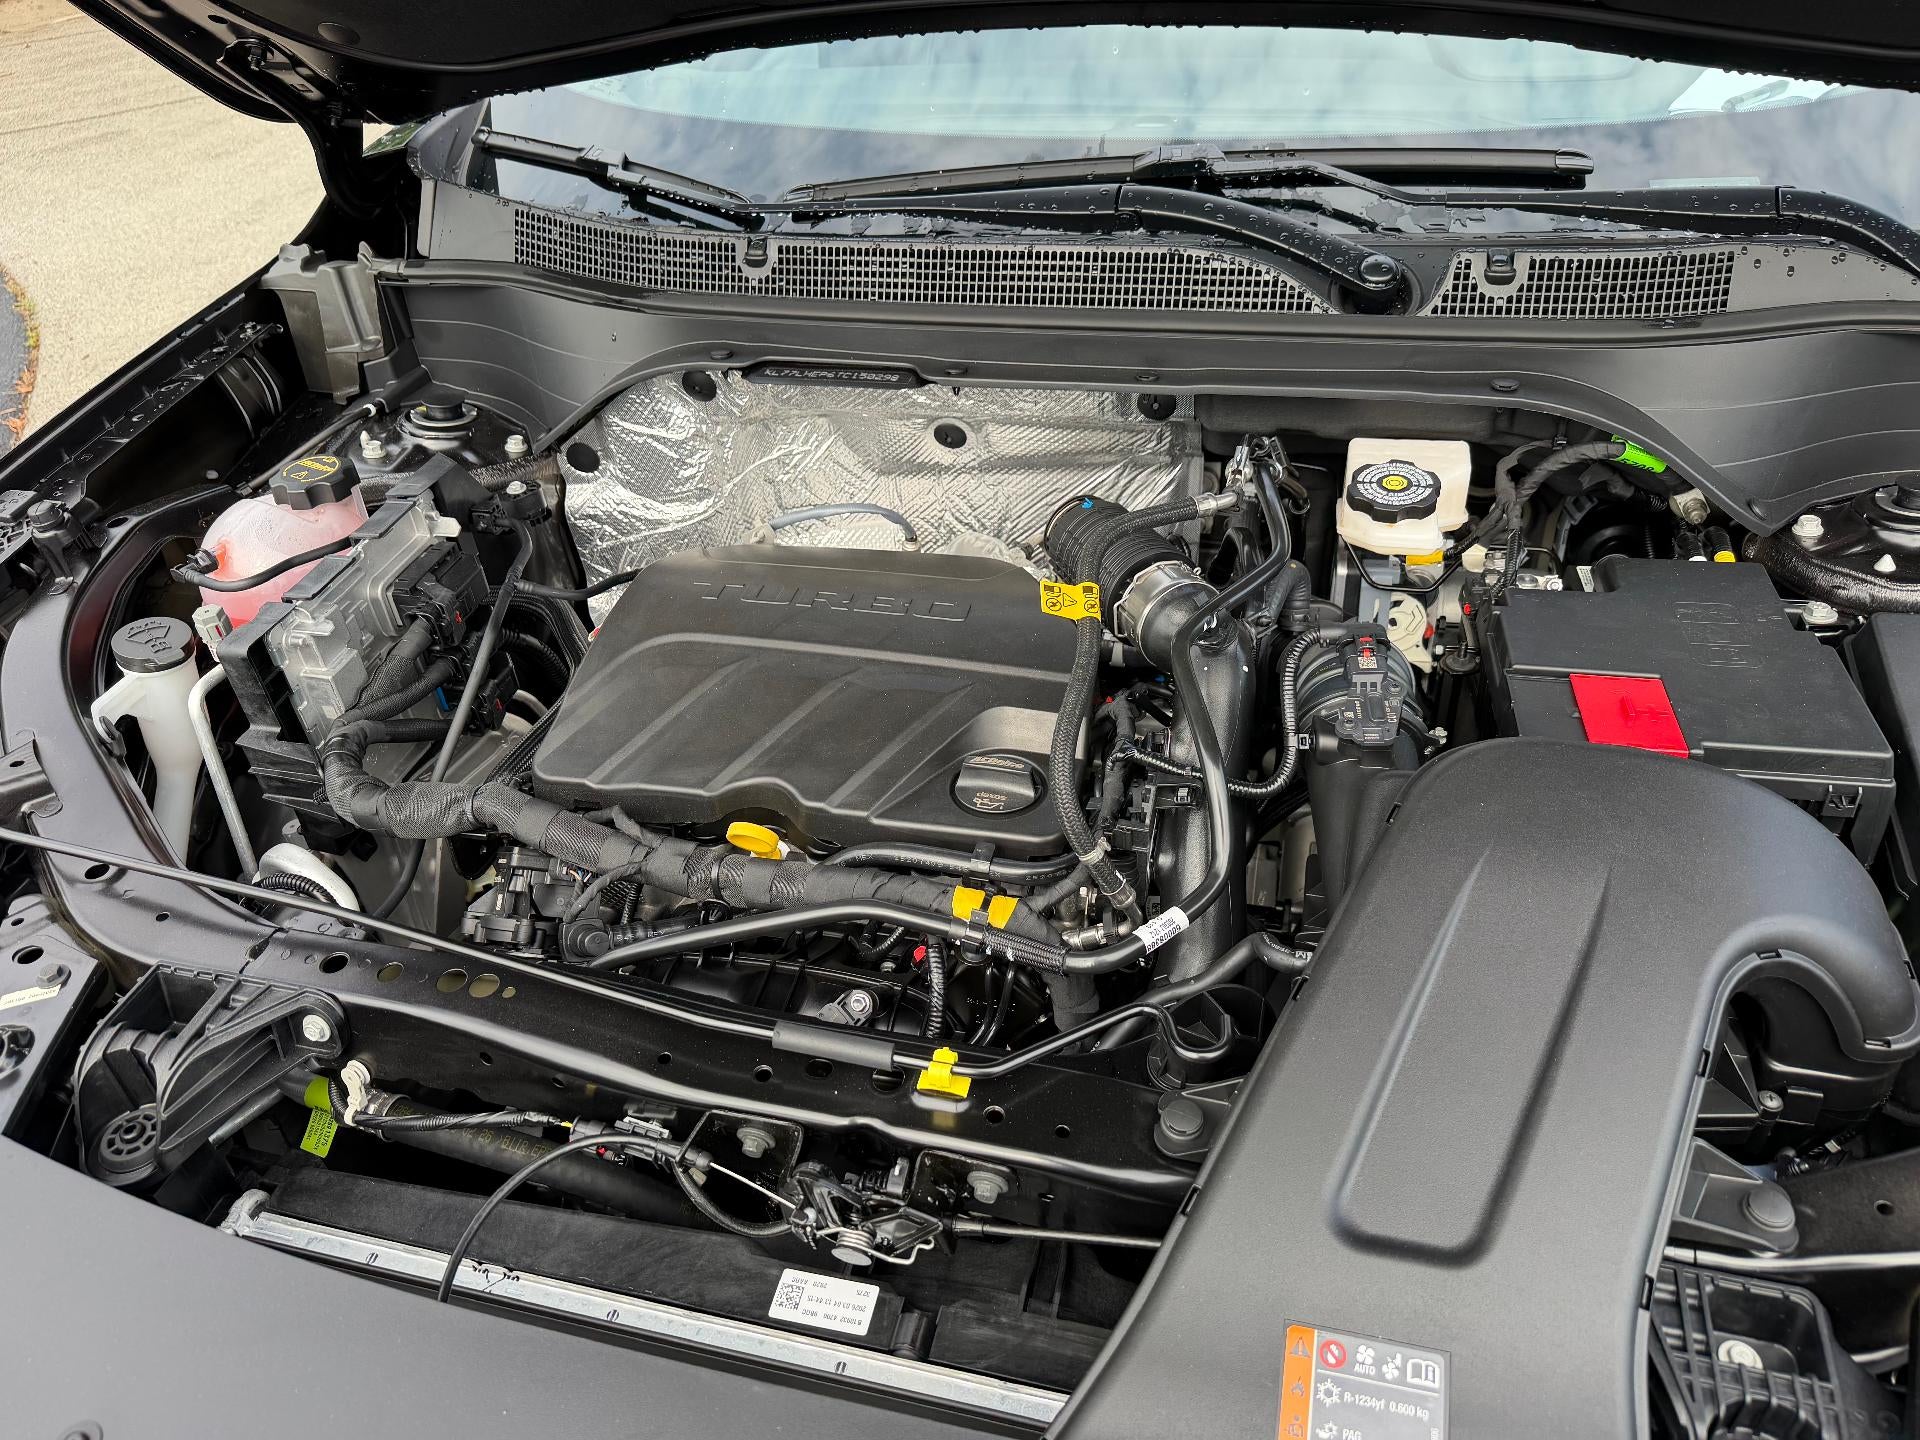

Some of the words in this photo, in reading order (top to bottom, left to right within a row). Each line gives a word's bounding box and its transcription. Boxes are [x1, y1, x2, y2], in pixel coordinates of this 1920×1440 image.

[764, 369, 900, 381] KL77LHEP6TC150298
[693, 581, 972, 622] TURBO
[1354, 1365, 1376, 1375] AUTO
[1343, 1392, 1385, 1411] R-1234yf
[1389, 1401, 1415, 1415] 0.600
[1417, 1405, 1429, 1421] kg
[1342, 1428, 1362, 1440] PAG
